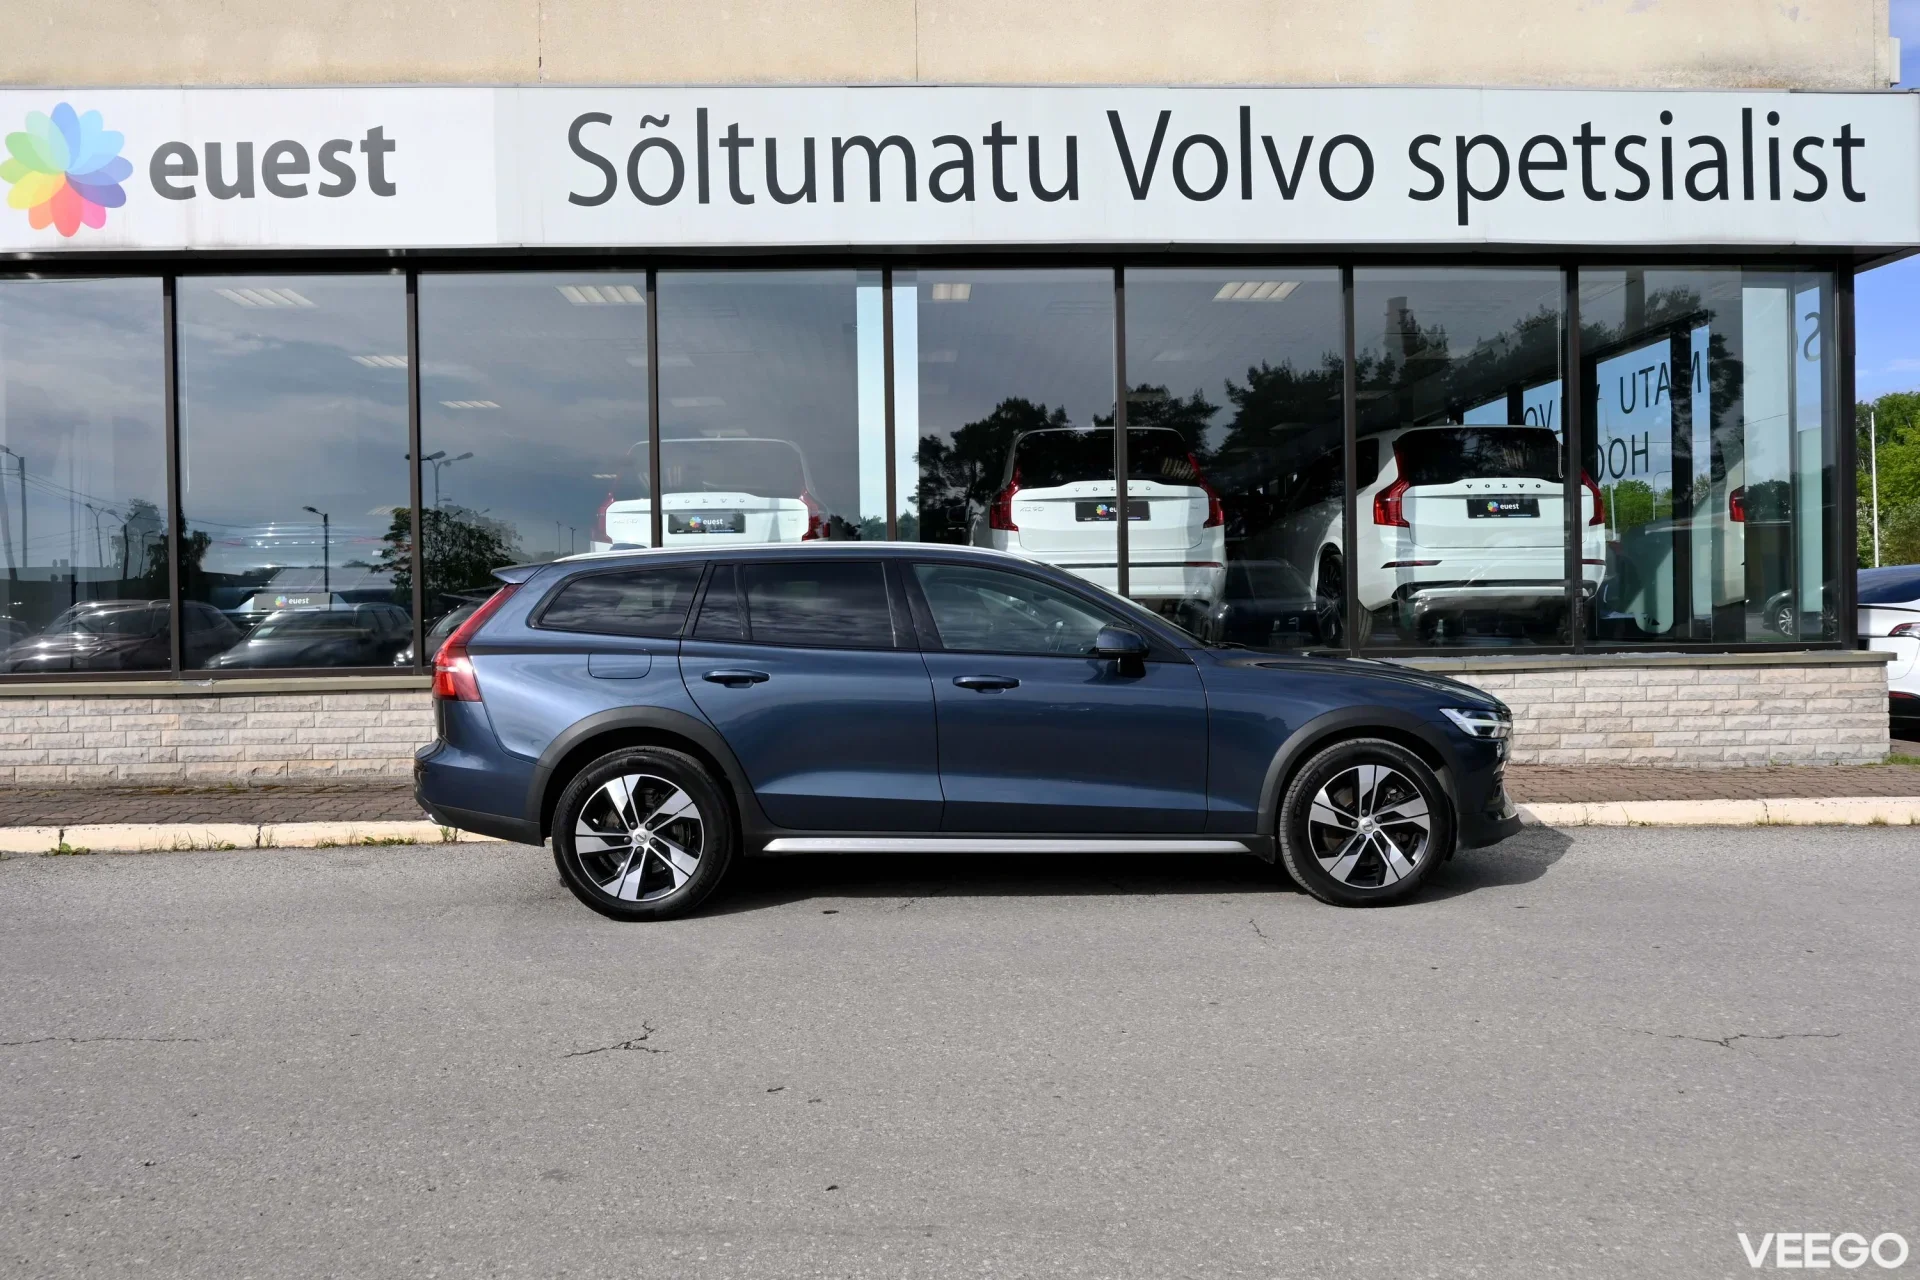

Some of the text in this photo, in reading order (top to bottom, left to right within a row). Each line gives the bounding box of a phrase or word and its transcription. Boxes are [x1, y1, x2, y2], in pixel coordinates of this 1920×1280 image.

[150, 126, 397, 201] euest
[568, 106, 1867, 226] Sõltumatu Volvo spetsialist
